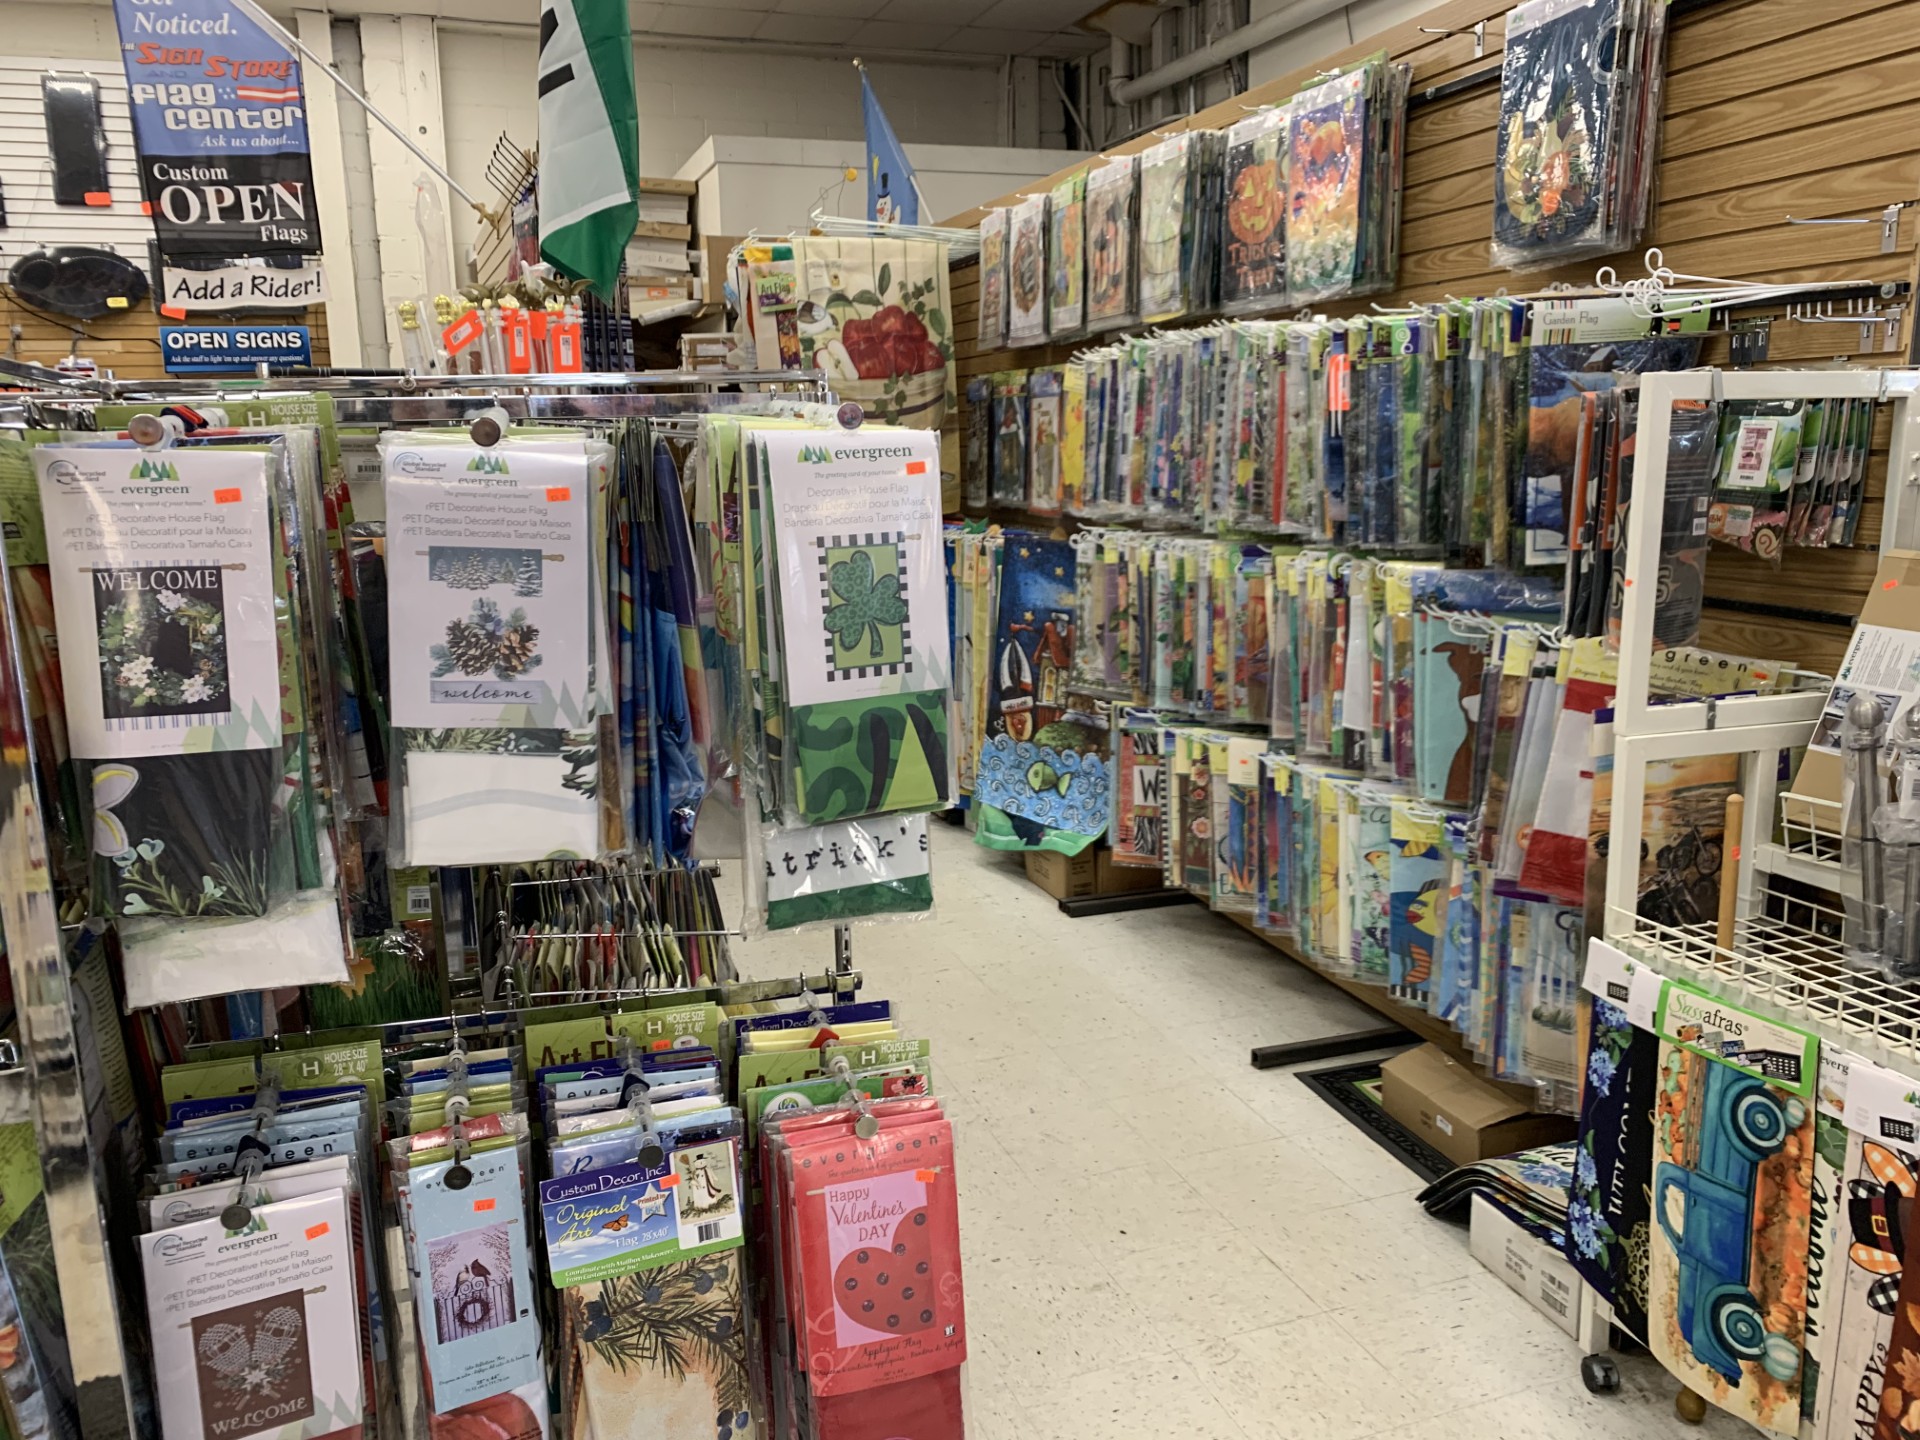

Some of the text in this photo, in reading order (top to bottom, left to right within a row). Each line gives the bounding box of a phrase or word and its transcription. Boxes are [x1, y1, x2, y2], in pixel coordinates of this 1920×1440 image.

[133, 11, 238, 36] Noticed.
[204, 55, 296, 81] STORE
[200, 133, 299, 147] Ask us about...
[153, 163, 229, 181] Custom
[160, 182, 305, 225] OPEN
[260, 224, 309, 244] Flags
[173, 270, 321, 300] Add a Rider!
[1579, 311, 1598, 325] Flag
[167, 331, 302, 349] OPEN SIGNS
[270, 403, 318, 415] HOUSE SIZE
[247, 411, 266, 427] H
[834, 446, 912, 462] evergreen
[121, 484, 190, 498] evergreen
[807, 483, 909, 497] Decorative House Flag
[426, 502, 547, 516] rPET Decorative House Flag
[783, 503, 823, 514] Drapeau
[869, 500, 890, 510] pour
[892, 499, 899, 507] la
[111, 513, 225, 524] Decorative House Flag
[424, 515, 462, 526] Drapeau
[506, 518, 528, 527] pour
[530, 518, 537, 526] la
[539, 519, 571, 528] Maison
[784, 518, 823, 528] Bandera
[825, 514, 873, 527] Decorativa
[876, 512, 910, 522] Tamaño
[179, 527, 203, 537] pour
[205, 527, 213, 535] la
[216, 526, 252, 535] Maison
[425, 528, 462, 537] Bandera
[464, 529, 512, 539] Decorativa
[513, 529, 548, 540] Tamaño
[550, 531, 571, 541] Casa
[188, 540, 226, 549] Tamaño
[97, 570, 219, 591] WELCOME
[1849, 631, 1865, 666] evergreen
[441, 683, 534, 700] welcome
[666, 1010, 706, 1024] HOUSE SIZE
[1669, 993, 1743, 1036] Sassafras
[647, 1021, 662, 1034] H
[880, 1040, 919, 1054] HOUSE SIZE
[324, 1048, 368, 1063] HOUSE SIZE
[861, 1050, 876, 1065] H
[302, 1062, 320, 1077] H
[547, 1165, 666, 1202] Custom Decor, Inc.
[829, 1187, 870, 1203] Happy
[557, 1195, 629, 1225] Original
[830, 1200, 907, 1226] Valentine's
[559, 1222, 593, 1248] Art
[858, 1223, 891, 1242] DAY
[217, 1233, 278, 1253] evergreen
[615, 1236, 638, 1248] Flag
[210, 1263, 258, 1280] Decorative
[260, 1256, 288, 1267] House
[290, 1249, 309, 1259] Flag
[601, 1261, 616, 1269] with
[616, 1257, 640, 1267] Mailbox
[187, 1282, 225, 1298] Drapeau
[269, 1265, 290, 1278] pour
[292, 1260, 300, 1269] la
[301, 1254, 333, 1267] Maison
[188, 1293, 226, 1308] Bandera
[228, 1281, 275, 1298] Decorativa
[277, 1271, 310, 1285] Tamaño
[312, 1264, 333, 1275] Casa
[211, 1396, 307, 1436] WELCOME
